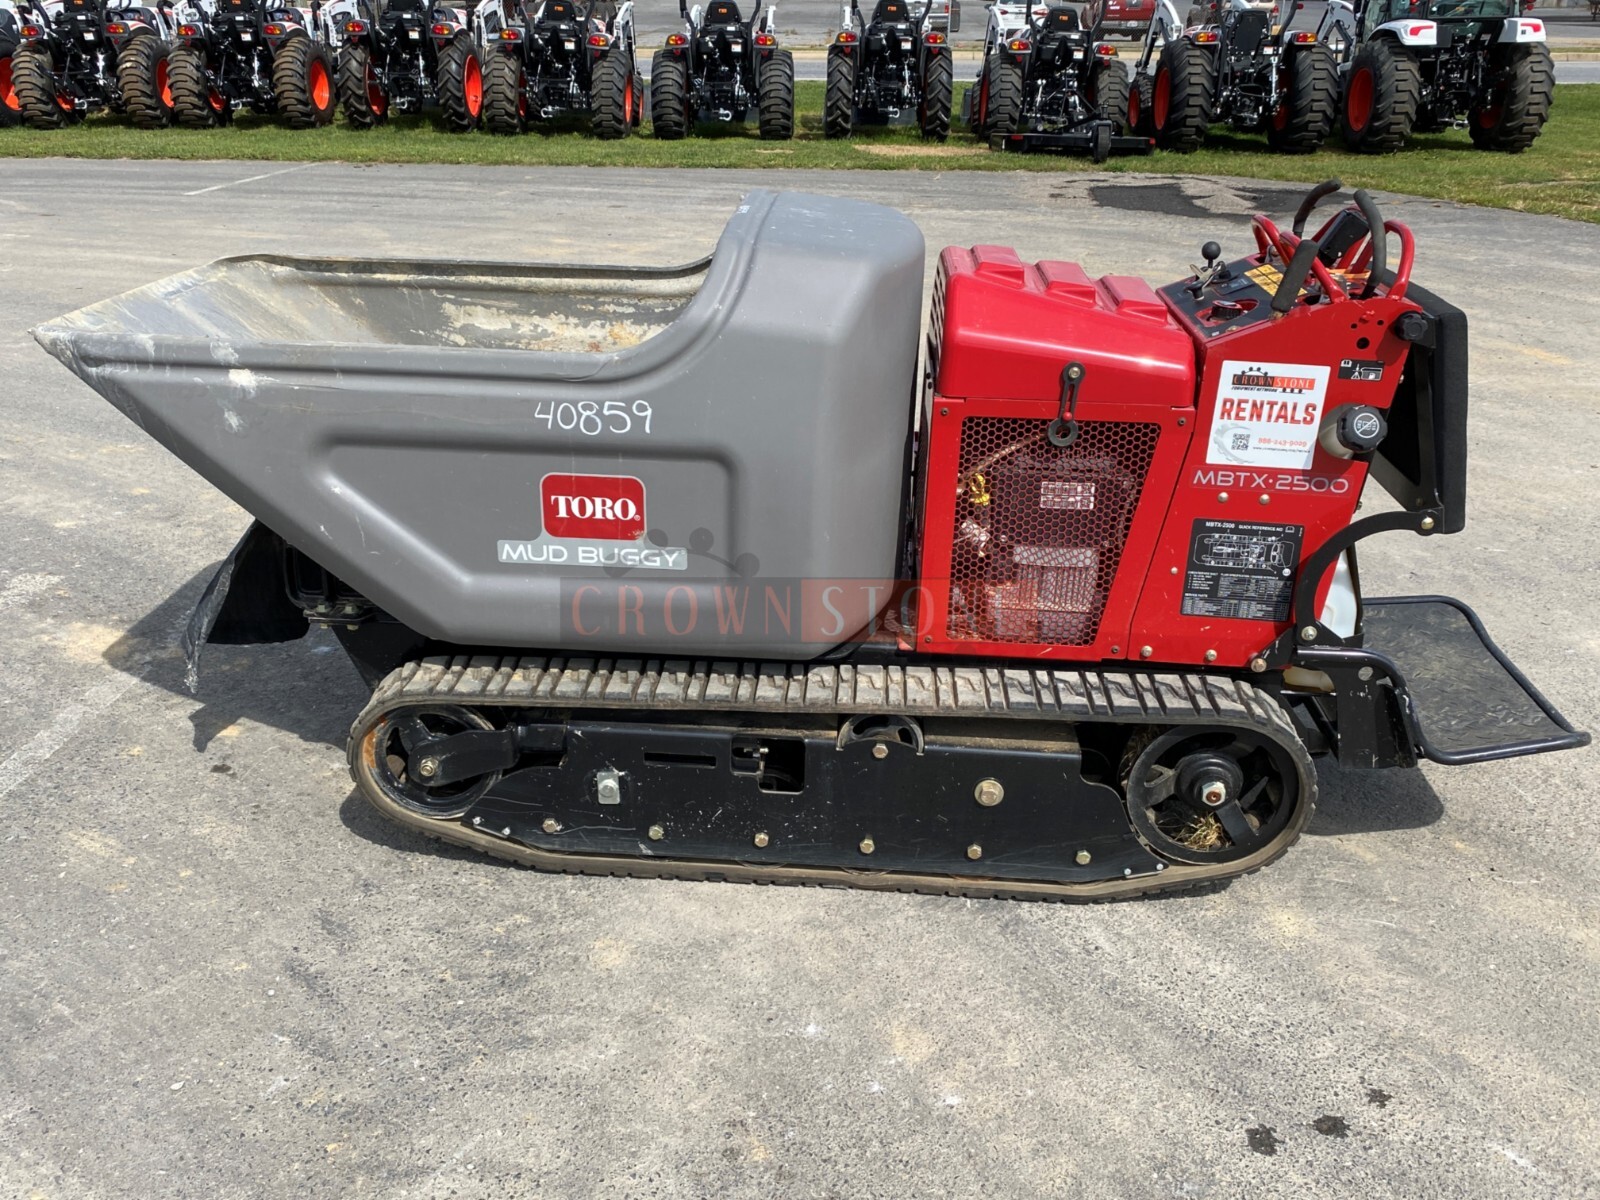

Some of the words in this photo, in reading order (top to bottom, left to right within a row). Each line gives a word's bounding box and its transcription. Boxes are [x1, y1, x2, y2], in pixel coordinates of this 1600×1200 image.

[1233, 375, 1273, 387] CROWN
[534, 400, 653, 435] 40859
[1219, 397, 1317, 426] RENTALS
[1205, 521, 1235, 529] MBTX-2500
[501, 543, 568, 563] MUD
[577, 546, 682, 568] BUGGY
